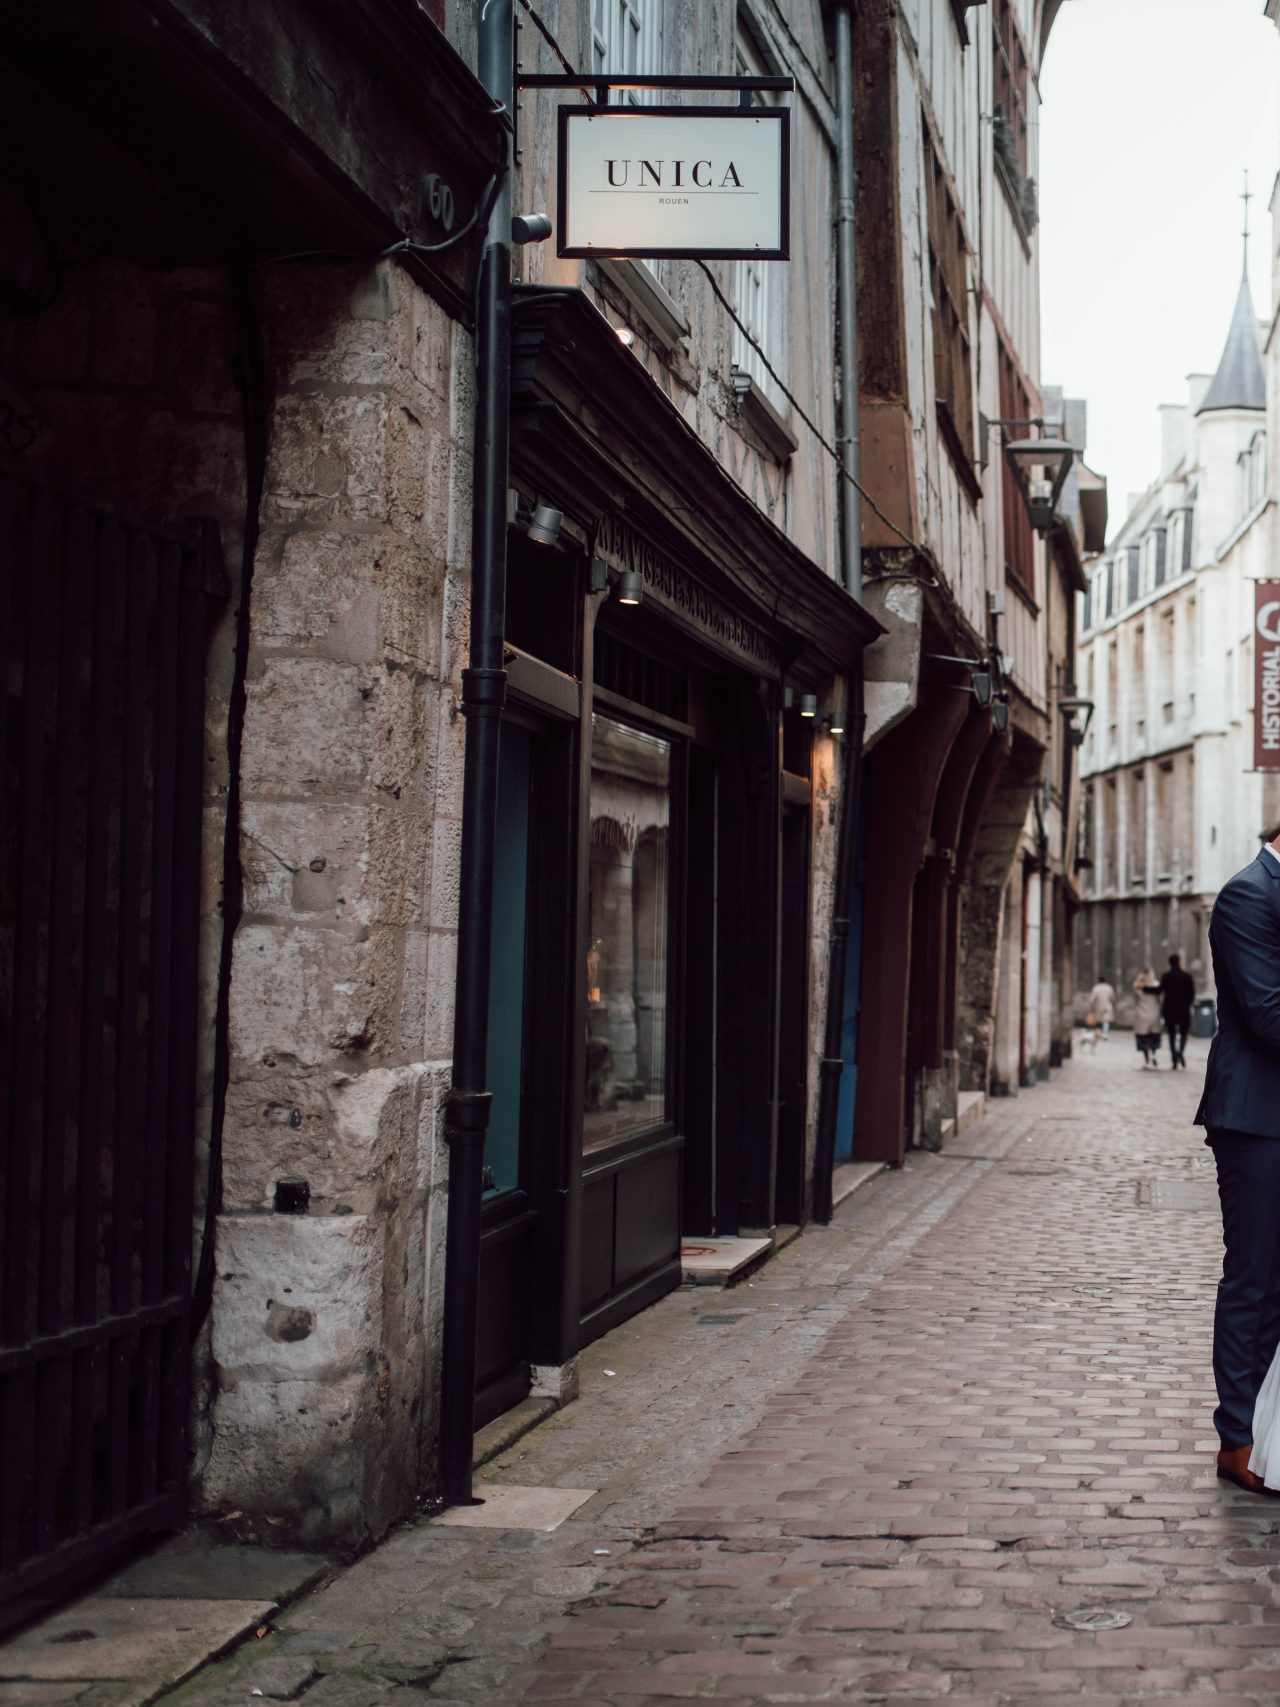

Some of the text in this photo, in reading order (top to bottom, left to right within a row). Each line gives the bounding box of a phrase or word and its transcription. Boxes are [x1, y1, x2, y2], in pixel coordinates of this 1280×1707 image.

[604, 159, 745, 188] UNICA
[659, 197, 690, 205] ROUEN
[1262, 645, 1280, 750] HISTORIAL
